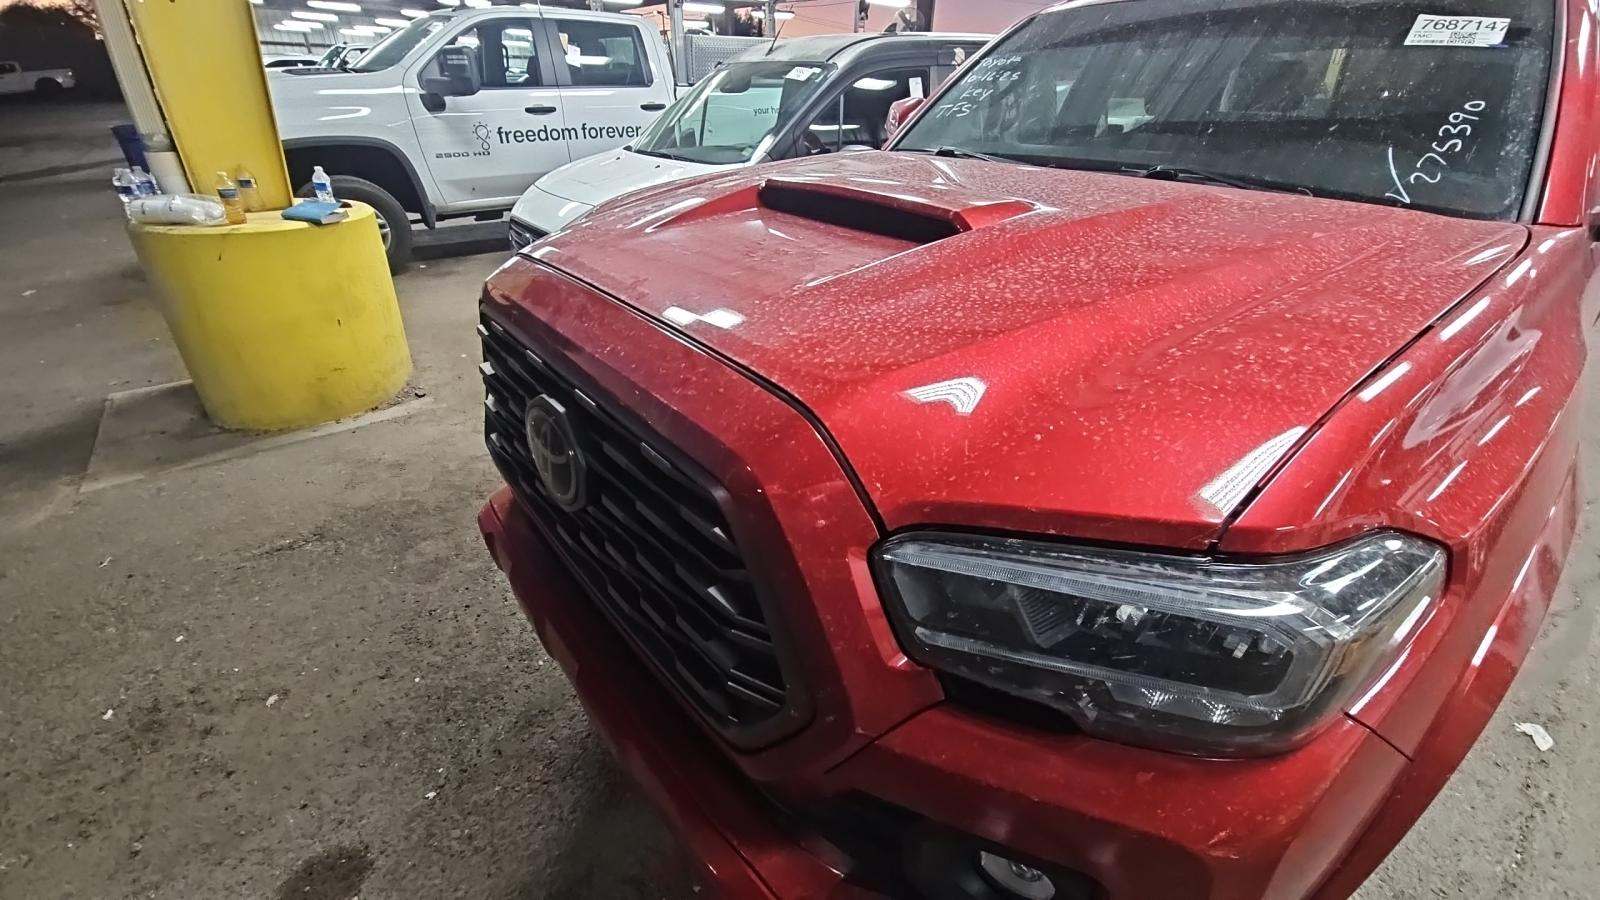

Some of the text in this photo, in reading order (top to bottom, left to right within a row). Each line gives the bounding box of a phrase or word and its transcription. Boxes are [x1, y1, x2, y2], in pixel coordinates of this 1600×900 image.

[1421, 18, 1510, 32] 7687147
[753, 107, 769, 116] your
[497, 122, 642, 144] freedom forever
[1410, 100, 1486, 184] 275390
[435, 150, 470, 159] 2500
